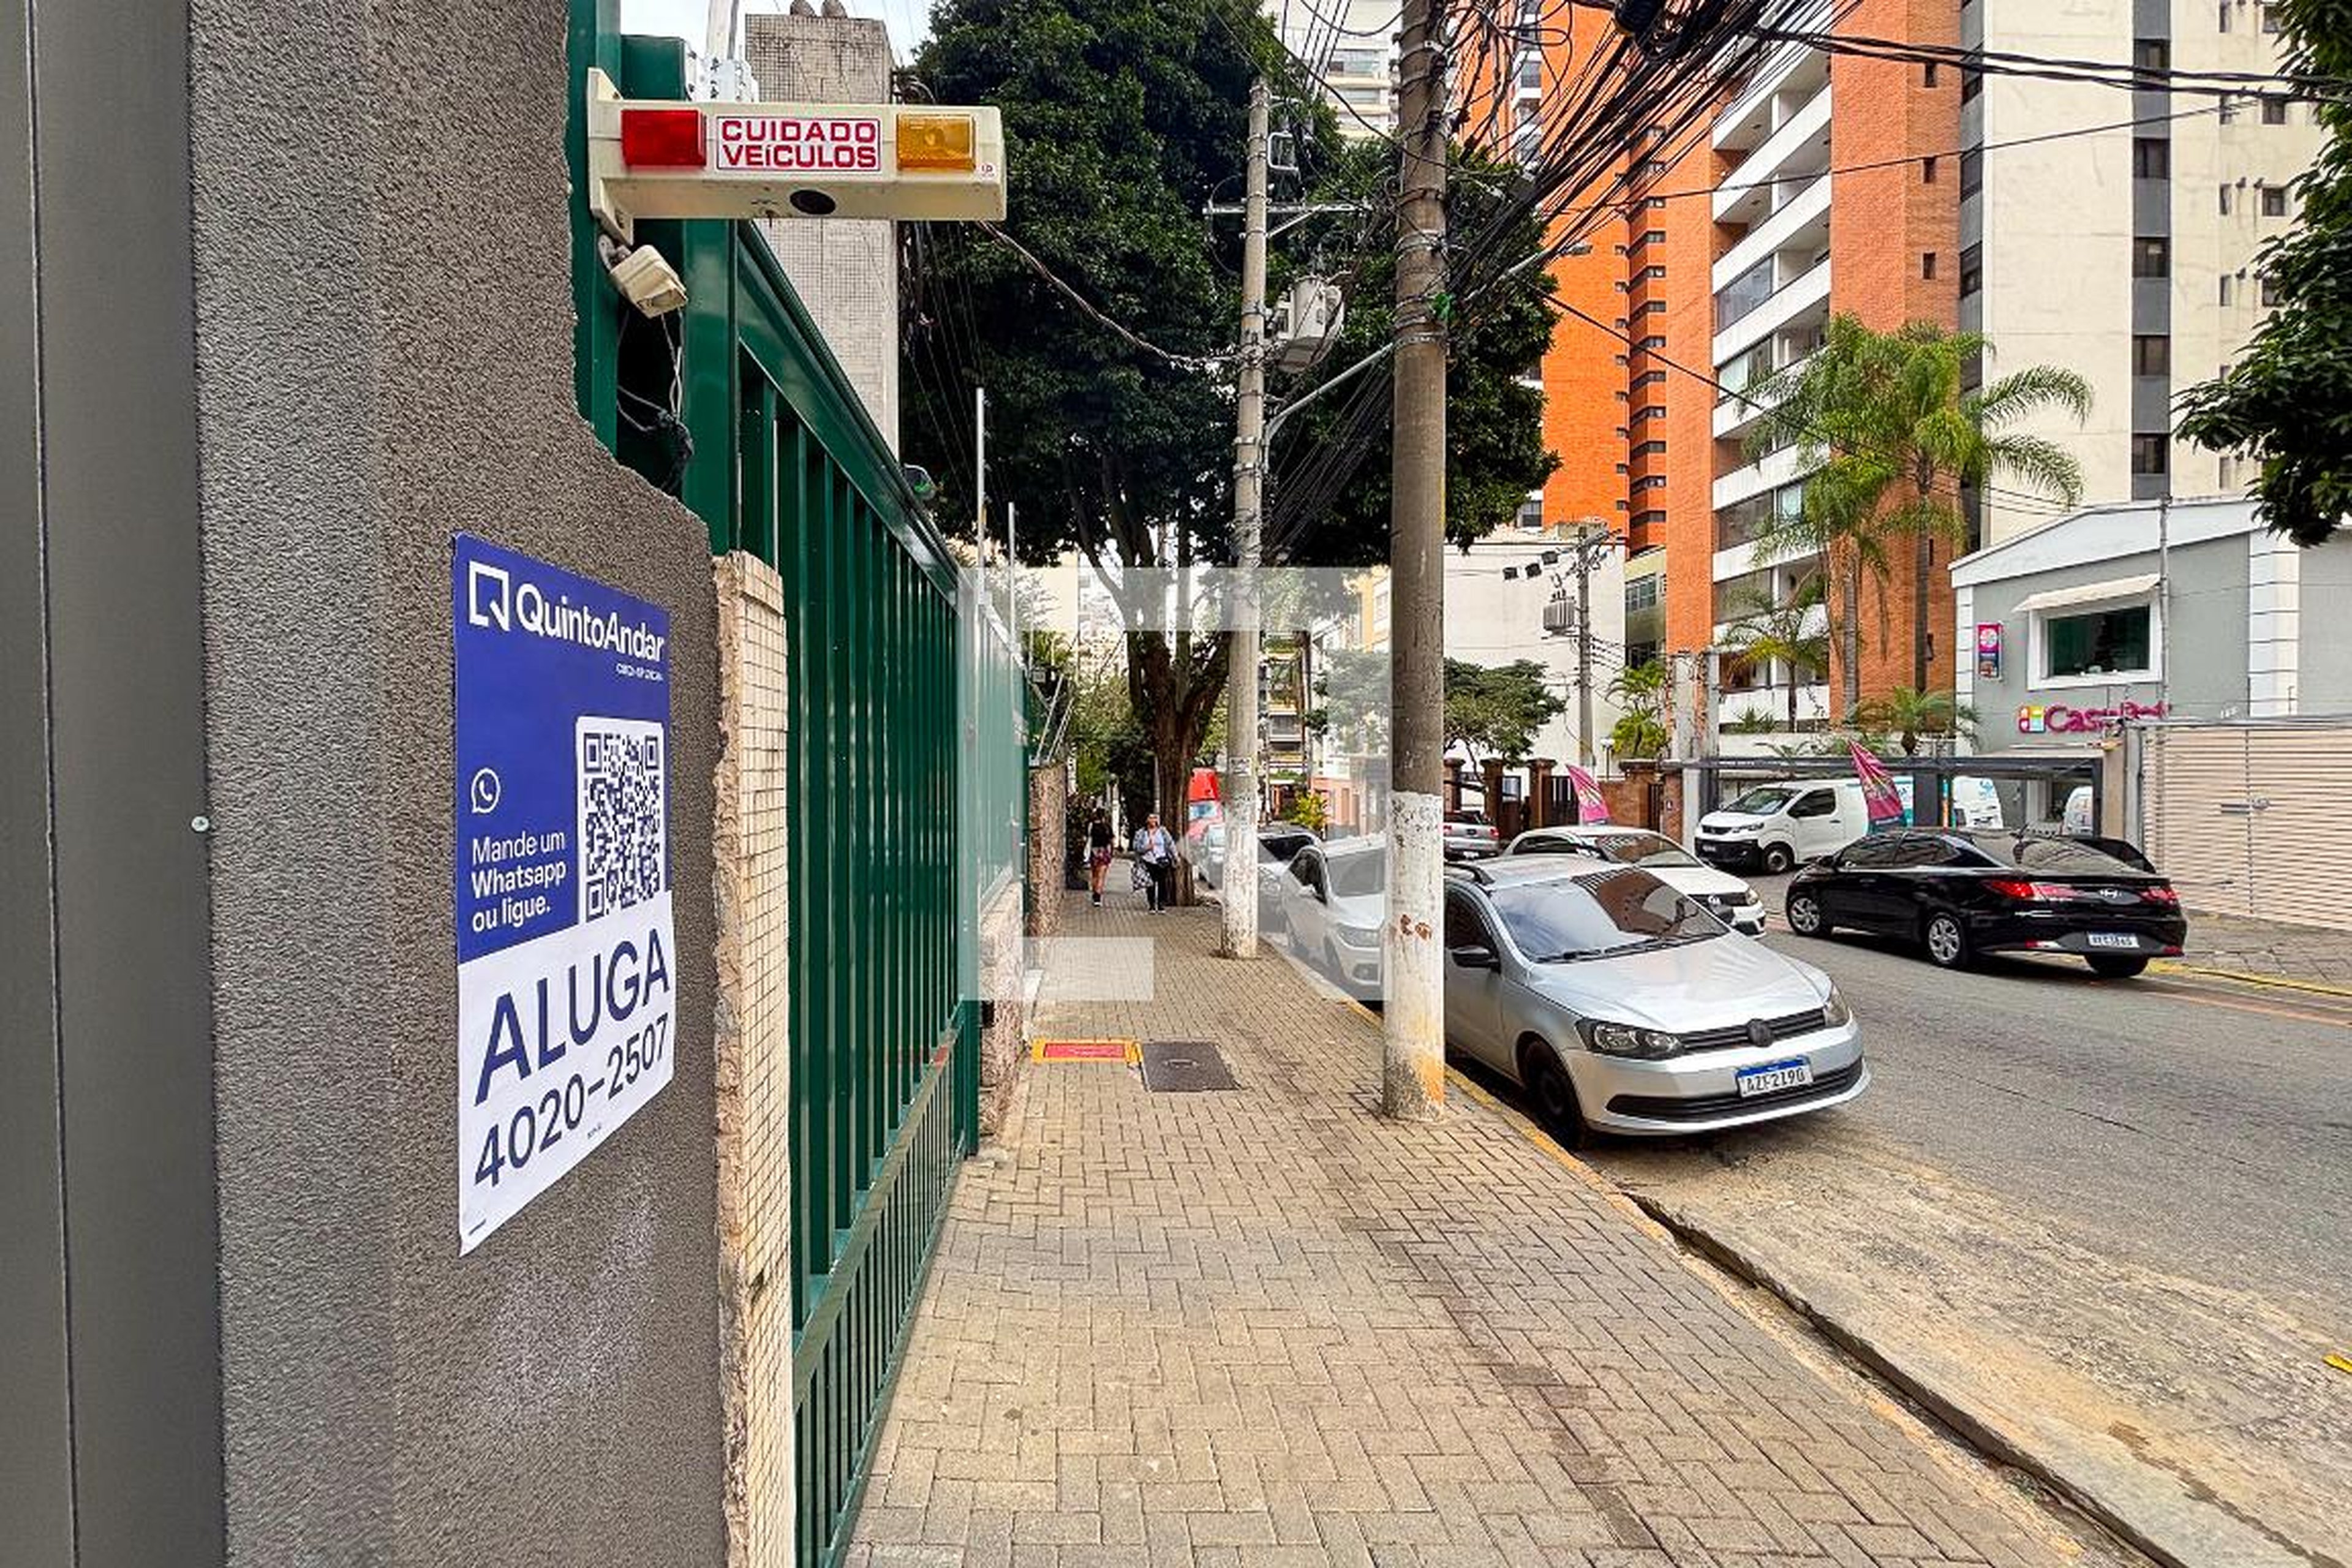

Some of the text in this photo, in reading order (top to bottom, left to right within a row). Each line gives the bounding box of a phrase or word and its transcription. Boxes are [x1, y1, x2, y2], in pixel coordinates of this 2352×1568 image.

[722, 120, 876, 143] CUIDADO
[516, 584, 665, 662] QuintoAndar
[472, 831, 565, 865] Mande um
[472, 861, 567, 899] Whatsapp
[473, 894, 551, 932] ou ligue.
[474, 929, 670, 1107] ALUGA
[474, 1012, 669, 1188] 4020-2507
